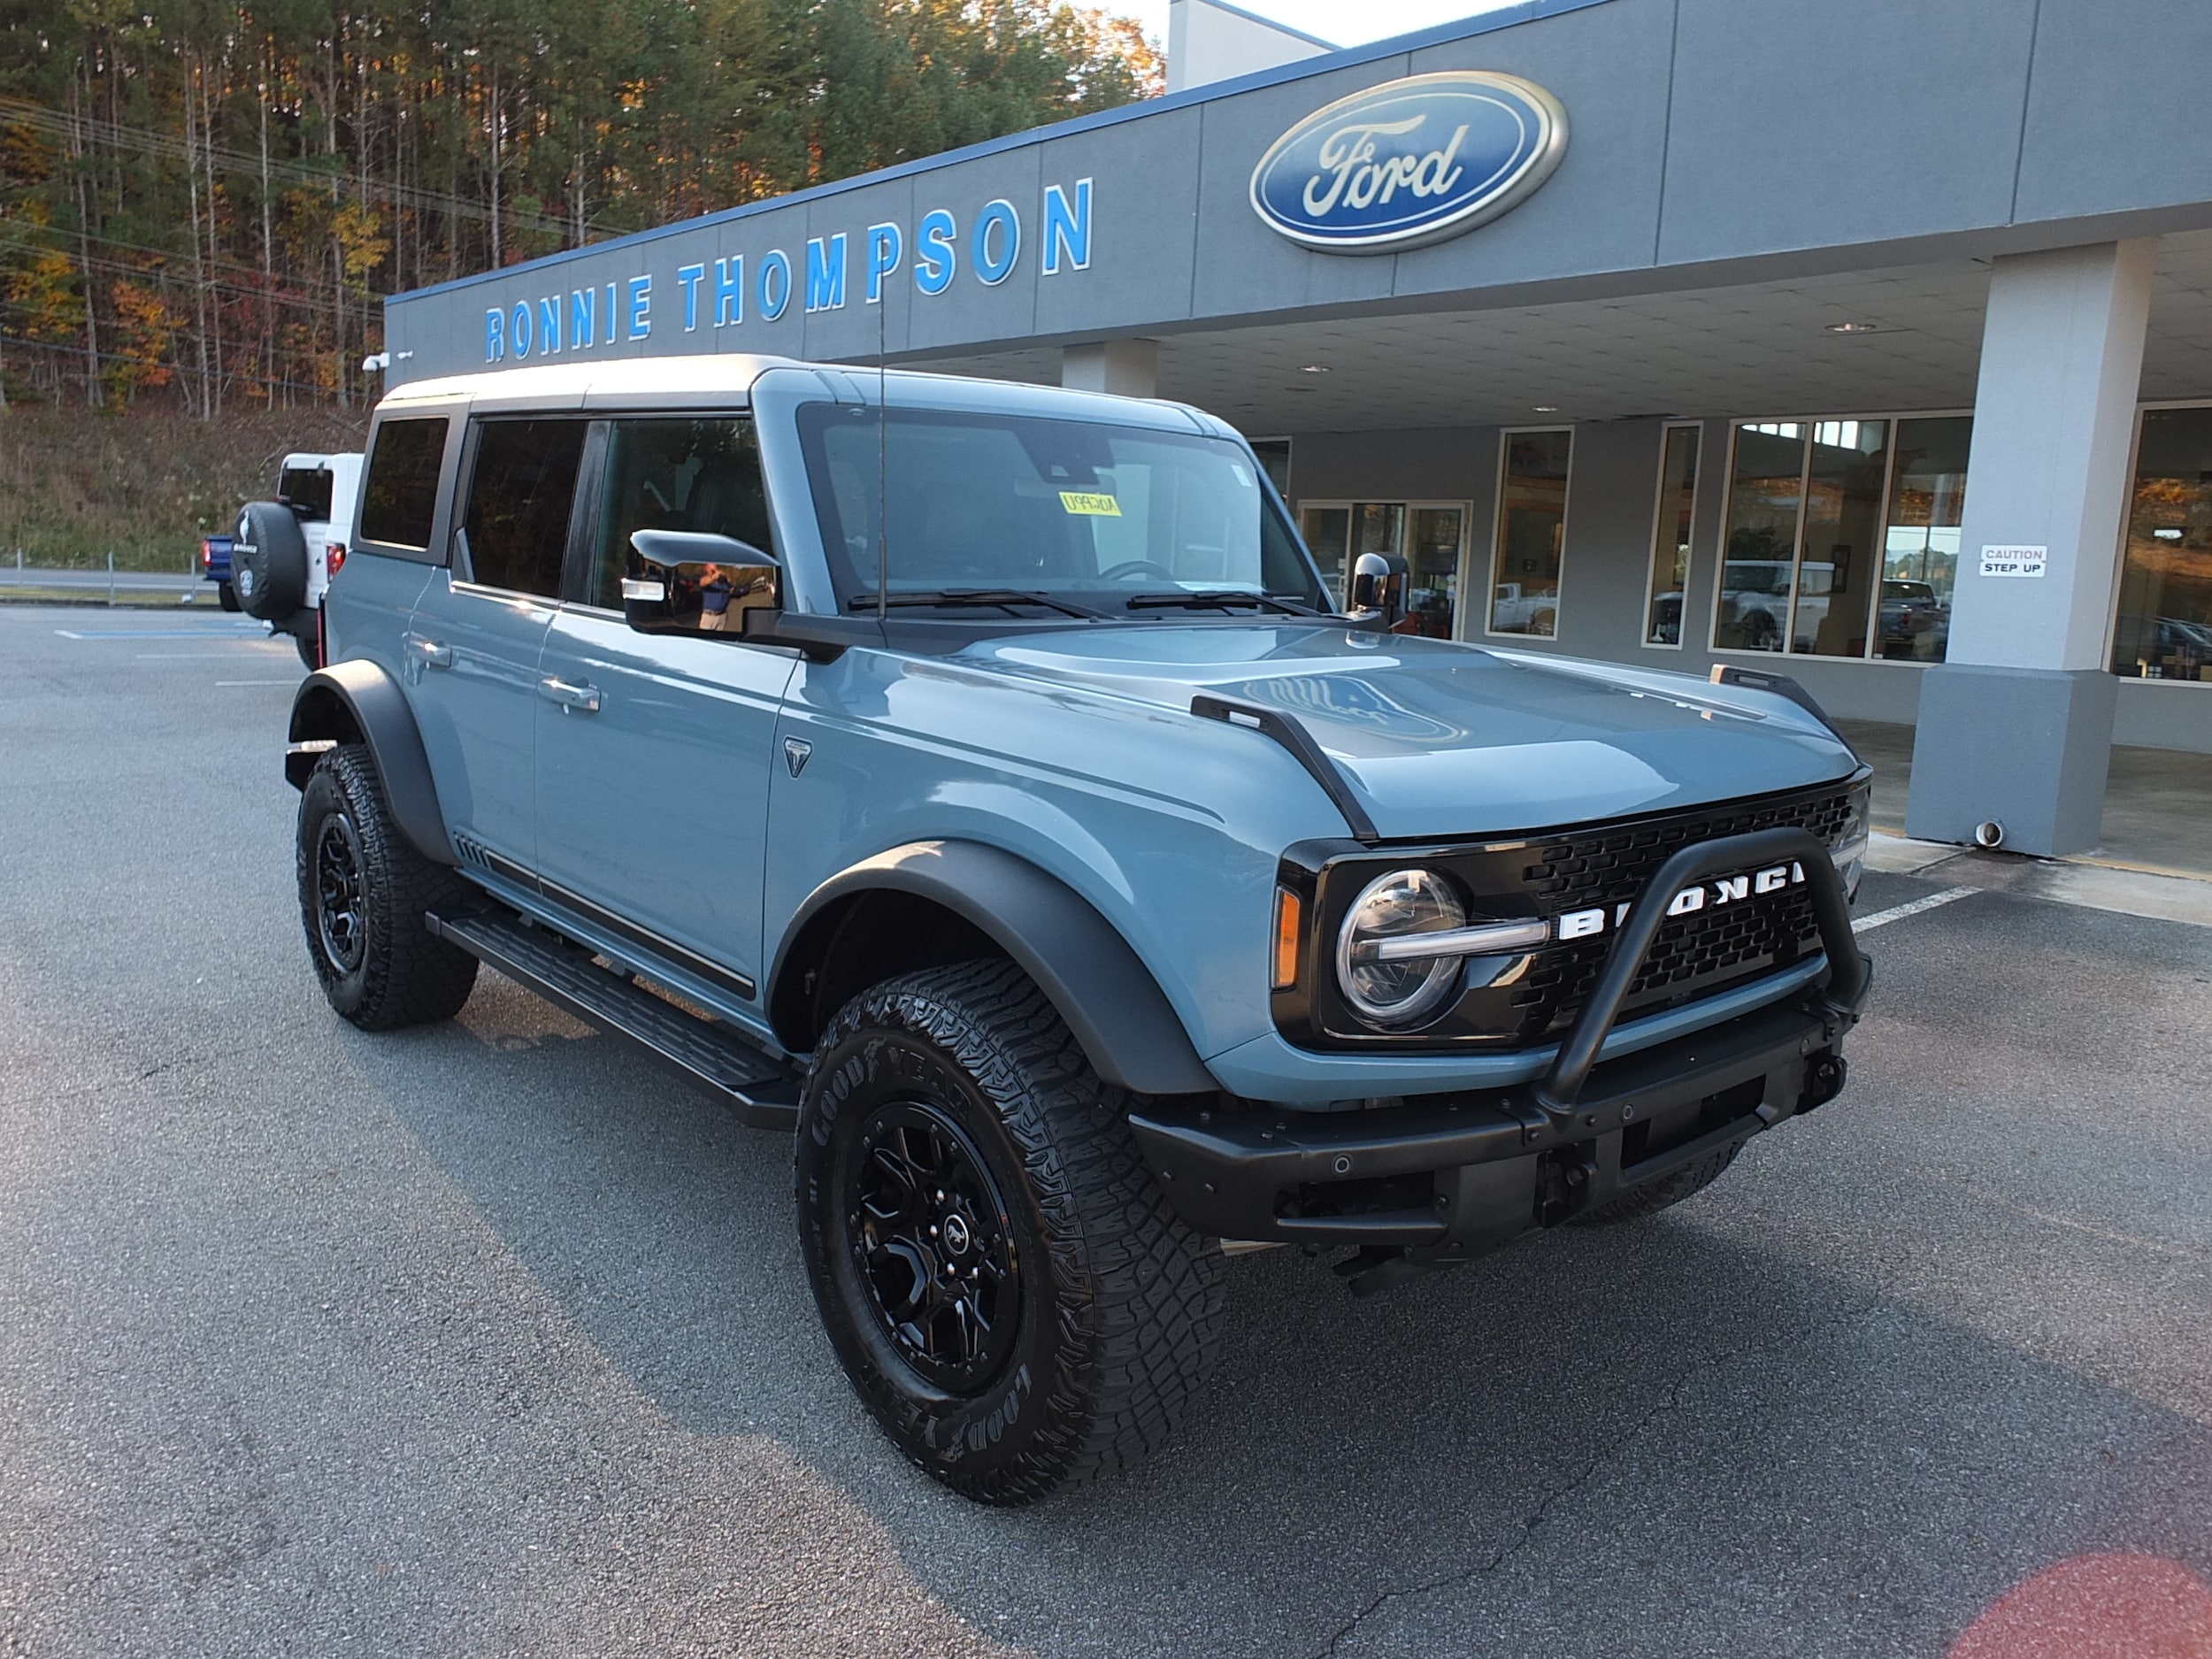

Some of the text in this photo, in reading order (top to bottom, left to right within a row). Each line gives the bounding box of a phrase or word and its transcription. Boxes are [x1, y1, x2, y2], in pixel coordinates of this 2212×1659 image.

[1302, 113, 1470, 218] Ford
[485, 177, 1094, 364] RONNIE THOMPSON
[1985, 563, 2018, 572] STEP
[1986, 550, 2043, 559] CAUTION
